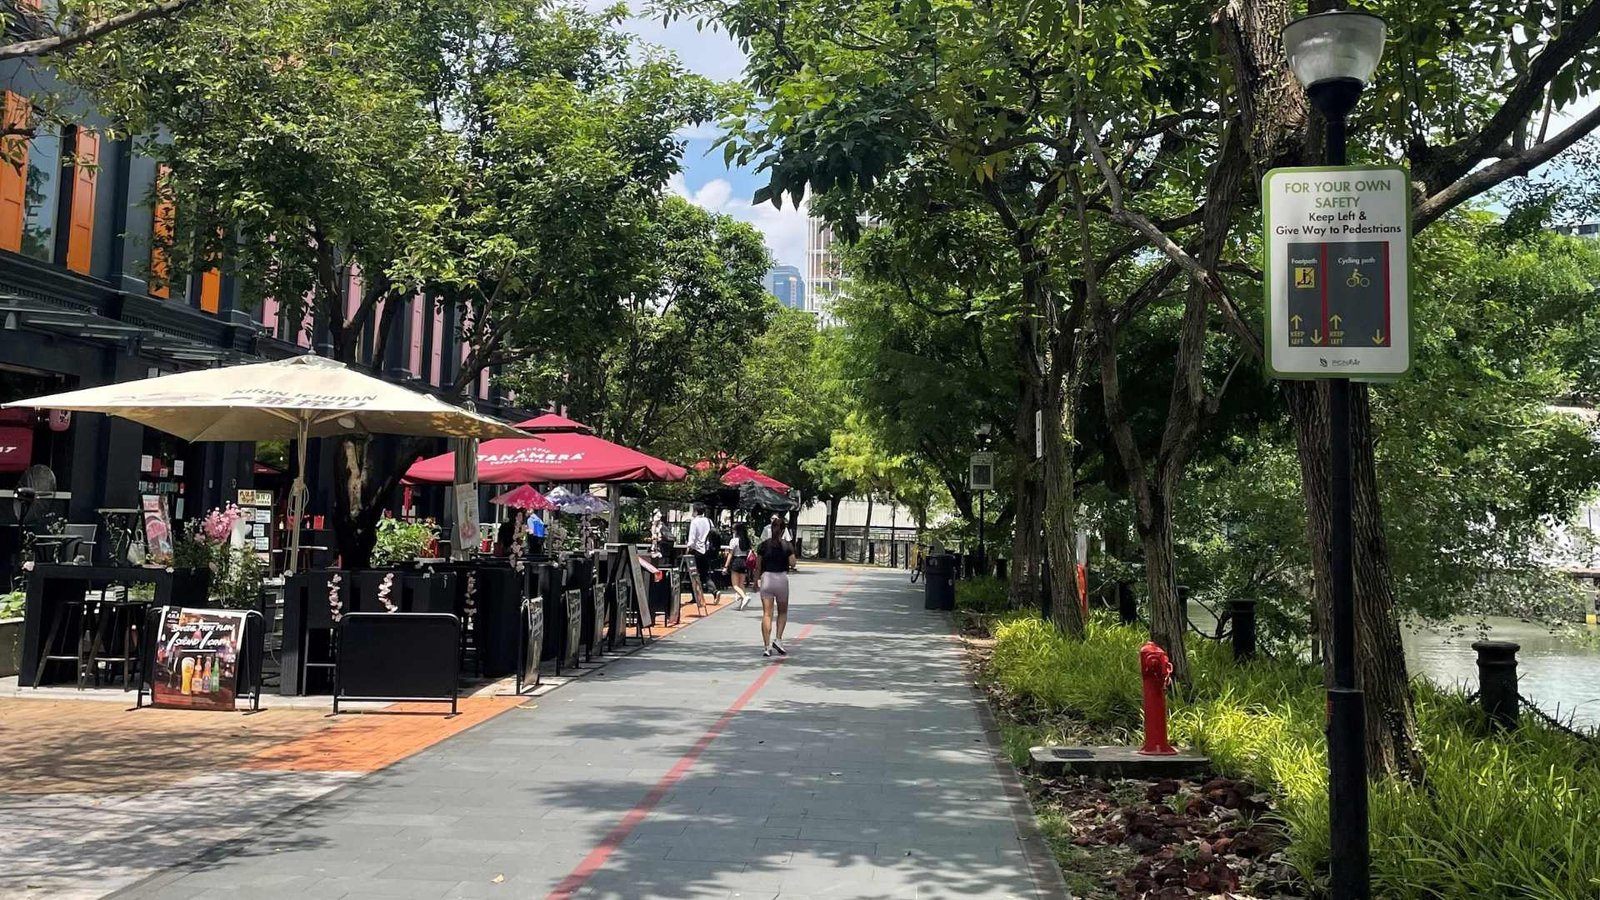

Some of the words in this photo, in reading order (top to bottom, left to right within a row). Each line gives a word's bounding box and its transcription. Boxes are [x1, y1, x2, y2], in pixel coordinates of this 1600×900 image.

[1285, 182, 1310, 193] FOR
[1315, 181, 1351, 193] YOUR
[1355, 180, 1391, 192] OWN
[1315, 197, 1361, 209] SAFETY
[1309, 212, 1335, 224] Keep
[1338, 210, 1356, 221] Left
[1359, 211, 1367, 221] &
[1276, 225, 1299, 235] Give
[1302, 225, 1327, 237] Way
[1330, 226, 1340, 234] to
[1343, 223, 1402, 234] Pedestrians
[1291, 258, 1318, 266] Footpath
[1337, 257, 1361, 265] Cycling
[1361, 257, 1376, 265] path
[232, 388, 289, 397] KIRIN
[477, 452, 584, 461] TANAMERA
